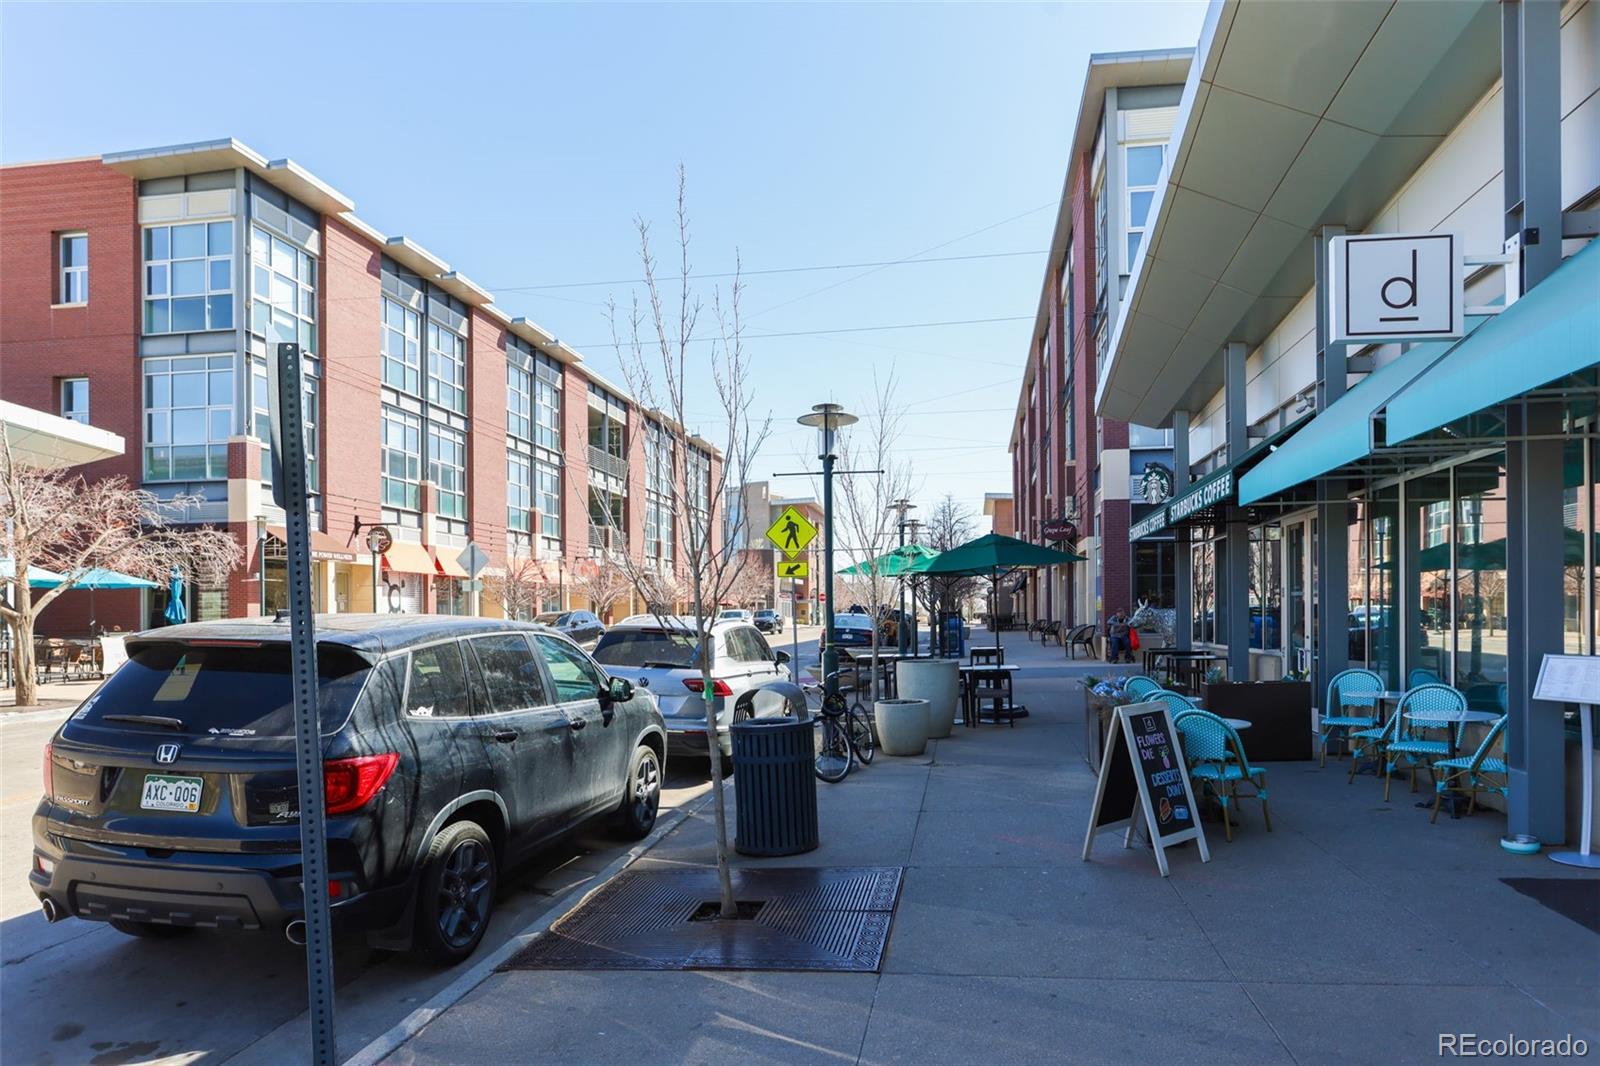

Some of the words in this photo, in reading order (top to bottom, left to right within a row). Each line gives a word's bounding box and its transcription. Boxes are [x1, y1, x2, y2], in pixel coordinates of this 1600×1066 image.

[1380, 249, 1418, 309] d
[1170, 489, 1203, 523] STARBUCKS
[1203, 475, 1230, 505] COFFEE
[1128, 519, 1149, 543] STARBUCKS
[1149, 510, 1166, 533] COFFEE
[1136, 733, 1165, 747] FLOWERS
[1141, 749, 1155, 760] DIE
[1151, 769, 1181, 786] DESSERTS
[155, 801, 184, 809] COLORADO
